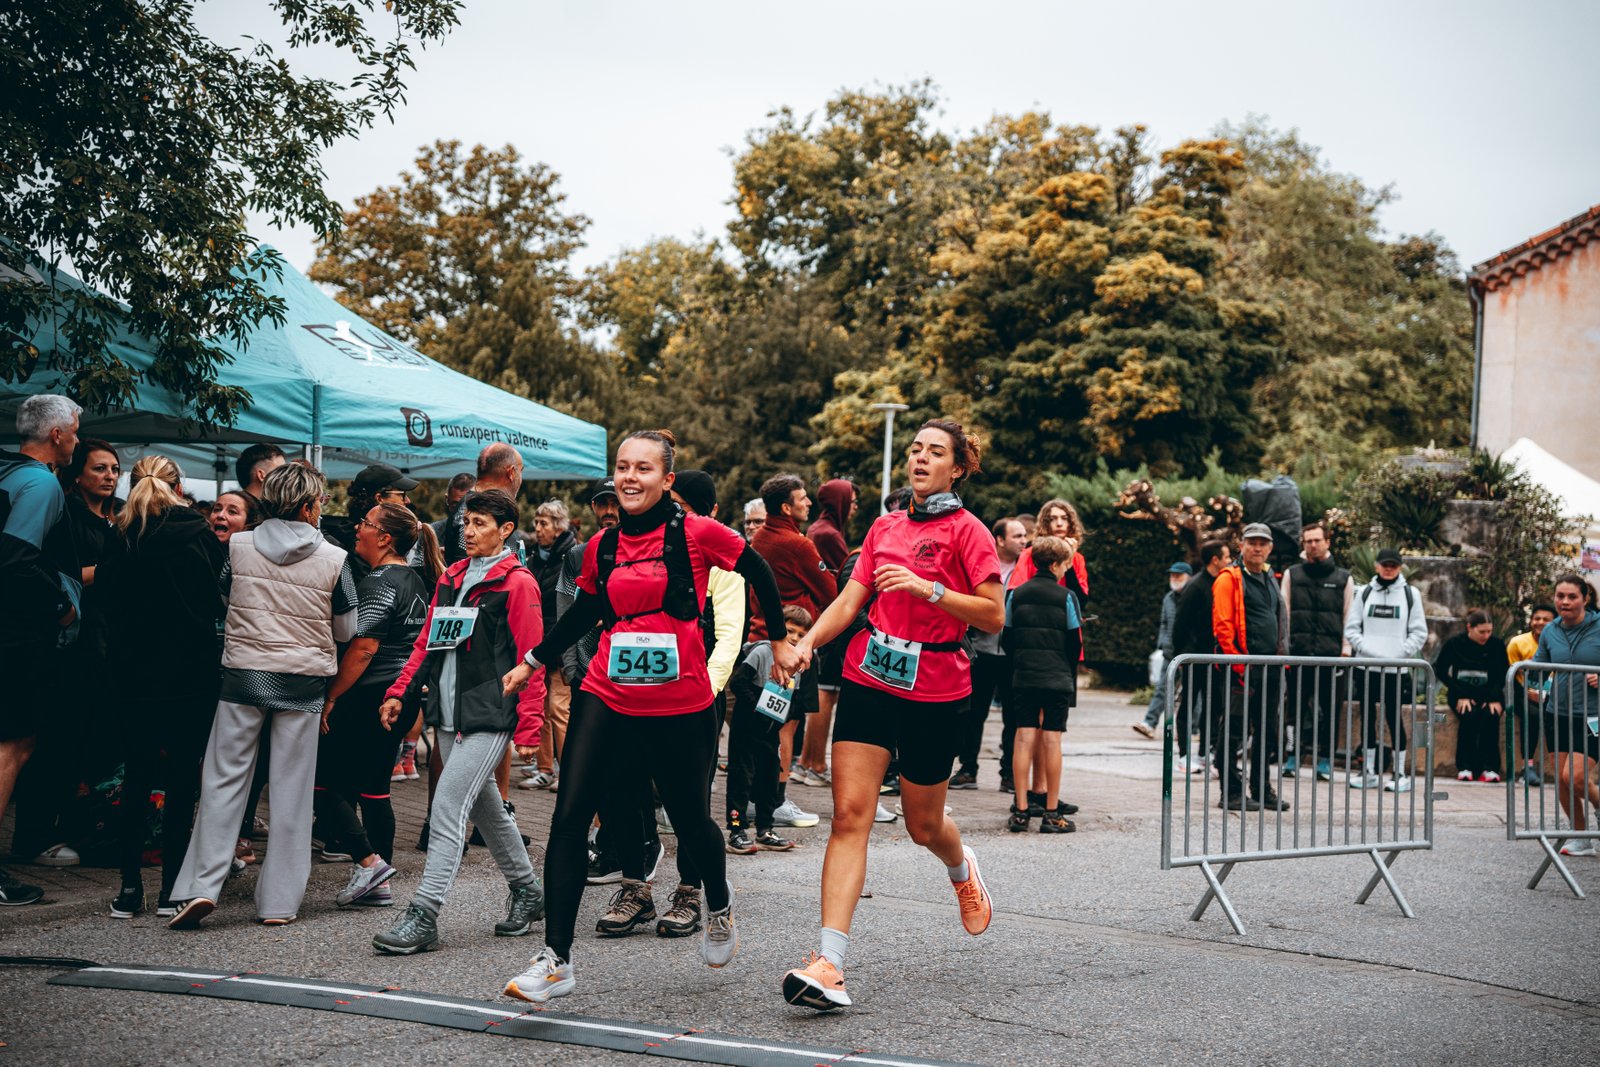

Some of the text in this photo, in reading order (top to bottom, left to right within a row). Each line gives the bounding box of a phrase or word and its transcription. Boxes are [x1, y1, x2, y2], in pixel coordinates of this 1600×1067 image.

[440, 423, 549, 451] runexpert valence
[617, 649, 669, 675] 543
[870, 643, 909, 678] 544
[766, 695, 788, 714] 557
